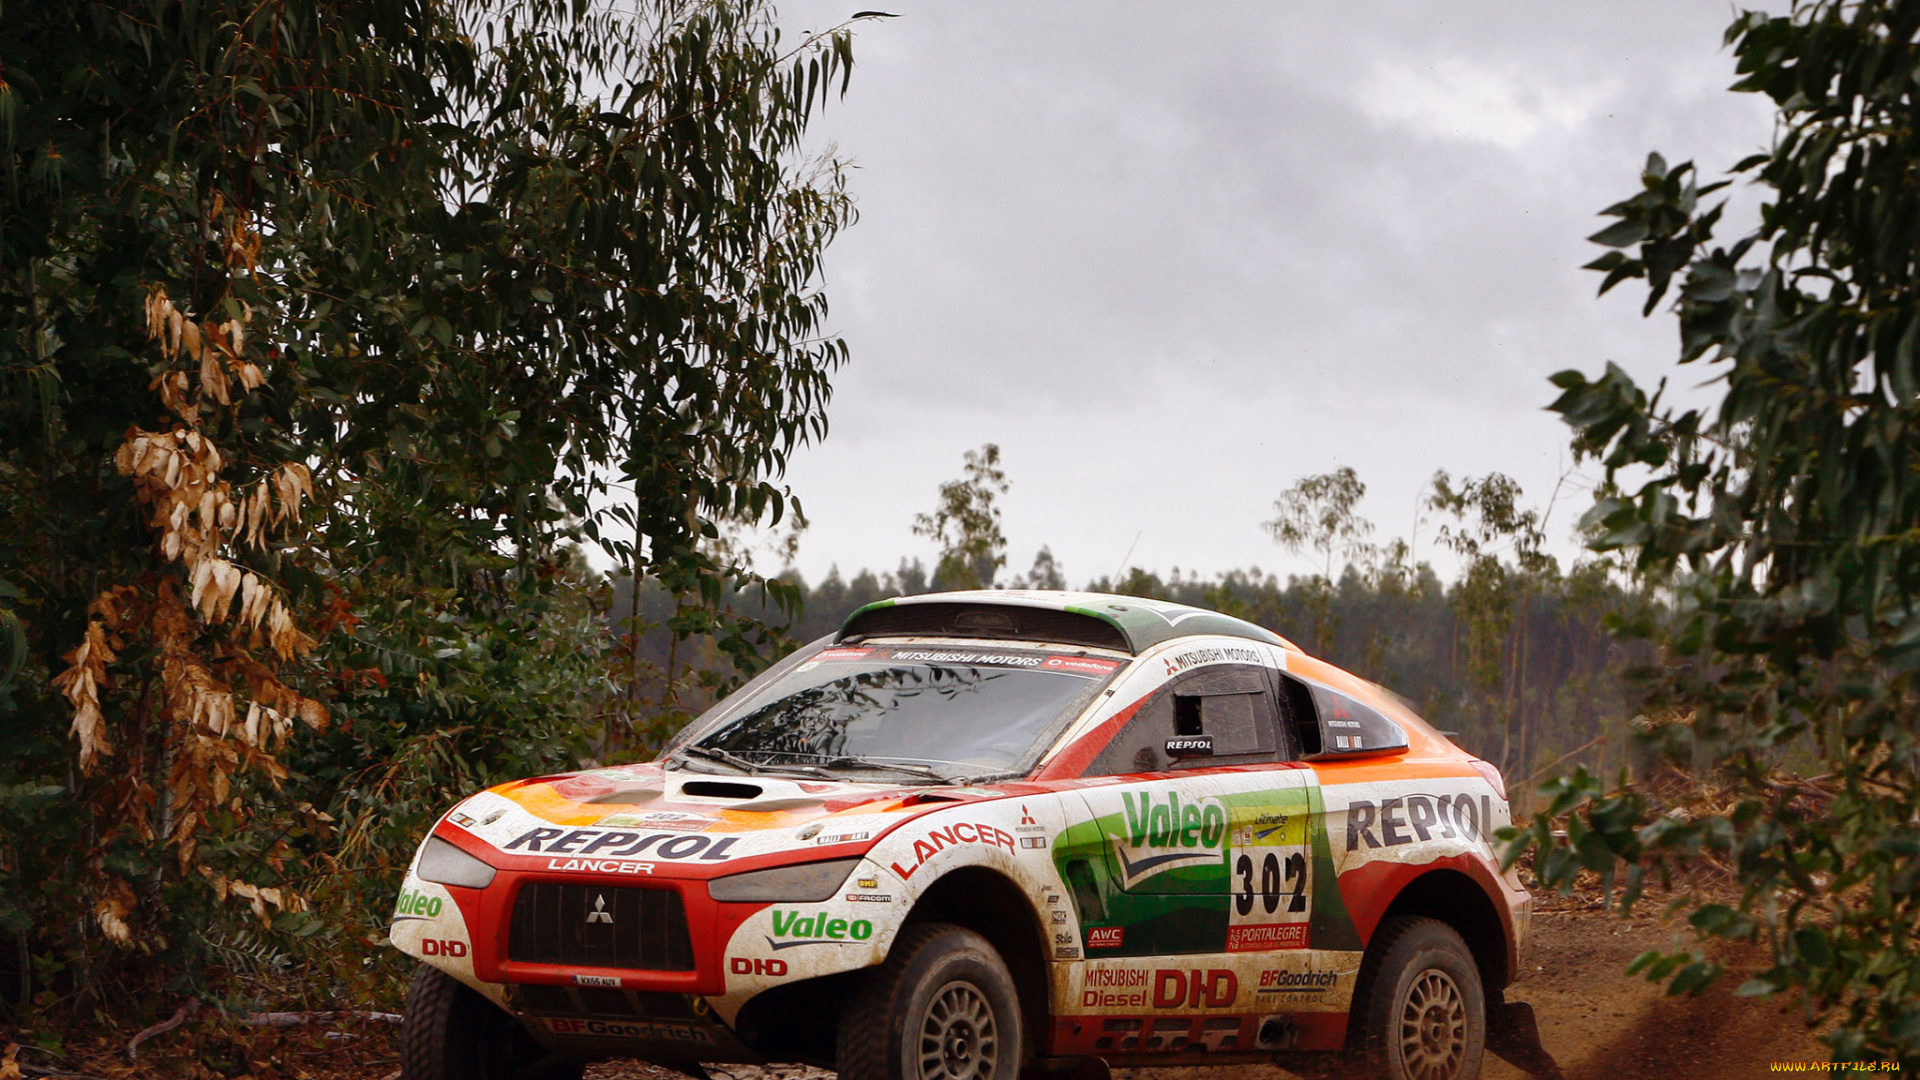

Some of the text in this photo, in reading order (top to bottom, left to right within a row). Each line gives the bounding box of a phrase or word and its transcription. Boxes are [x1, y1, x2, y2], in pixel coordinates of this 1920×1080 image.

[892, 651, 1042, 666] MITSUBISHI MOTORS
[1065, 661, 1114, 671] vodafone
[1175, 648, 1260, 669] MITSUBISHI MOTORS
[1166, 739, 1212, 750] REPSOL
[1121, 792, 1226, 848] Valeo
[1255, 813, 1288, 824] ultimate
[1346, 793, 1497, 851] REPSOL
[504, 827, 740, 860] REPSOL
[891, 823, 1015, 880] LANCER
[547, 859, 655, 874] LANCER
[1236, 853, 1307, 916] 302
[773, 910, 872, 940] Valeo
[1091, 929, 1121, 940] AWC
[1241, 926, 1302, 942] PORTALEGRE
[1085, 969, 1149, 987] MITSUBISHI
[1259, 970, 1338, 986] BFGoodrich
[1083, 990, 1148, 1007] Diesel
[551, 1019, 707, 1040] BFGoodrich
